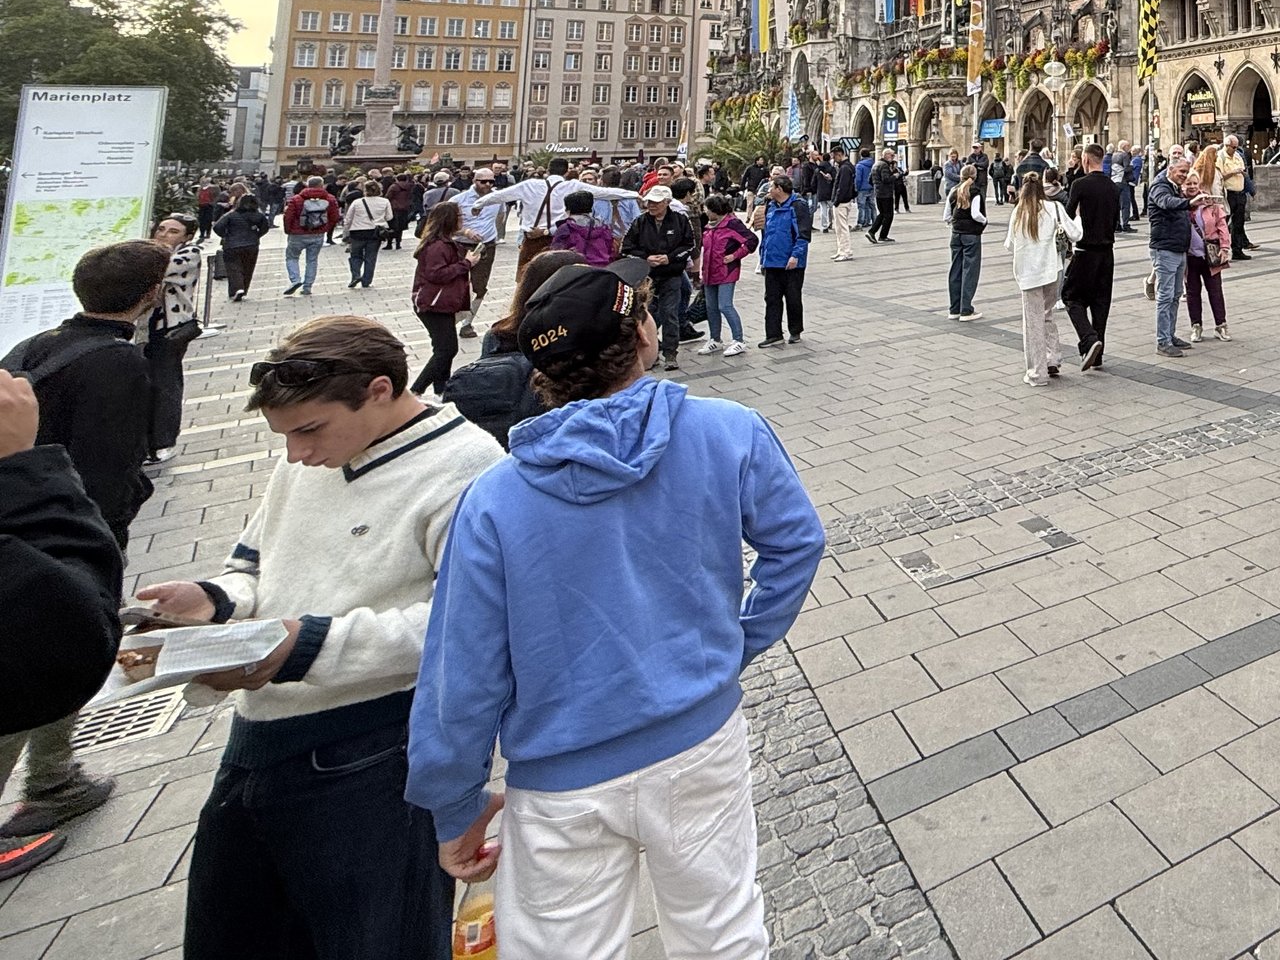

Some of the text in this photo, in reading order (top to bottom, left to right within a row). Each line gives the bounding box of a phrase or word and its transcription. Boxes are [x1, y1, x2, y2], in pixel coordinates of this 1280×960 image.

[32, 92, 132, 104] Marienplatz
[886, 106, 897, 118] S
[886, 121, 896, 133] U
[531, 325, 568, 352] 2024
